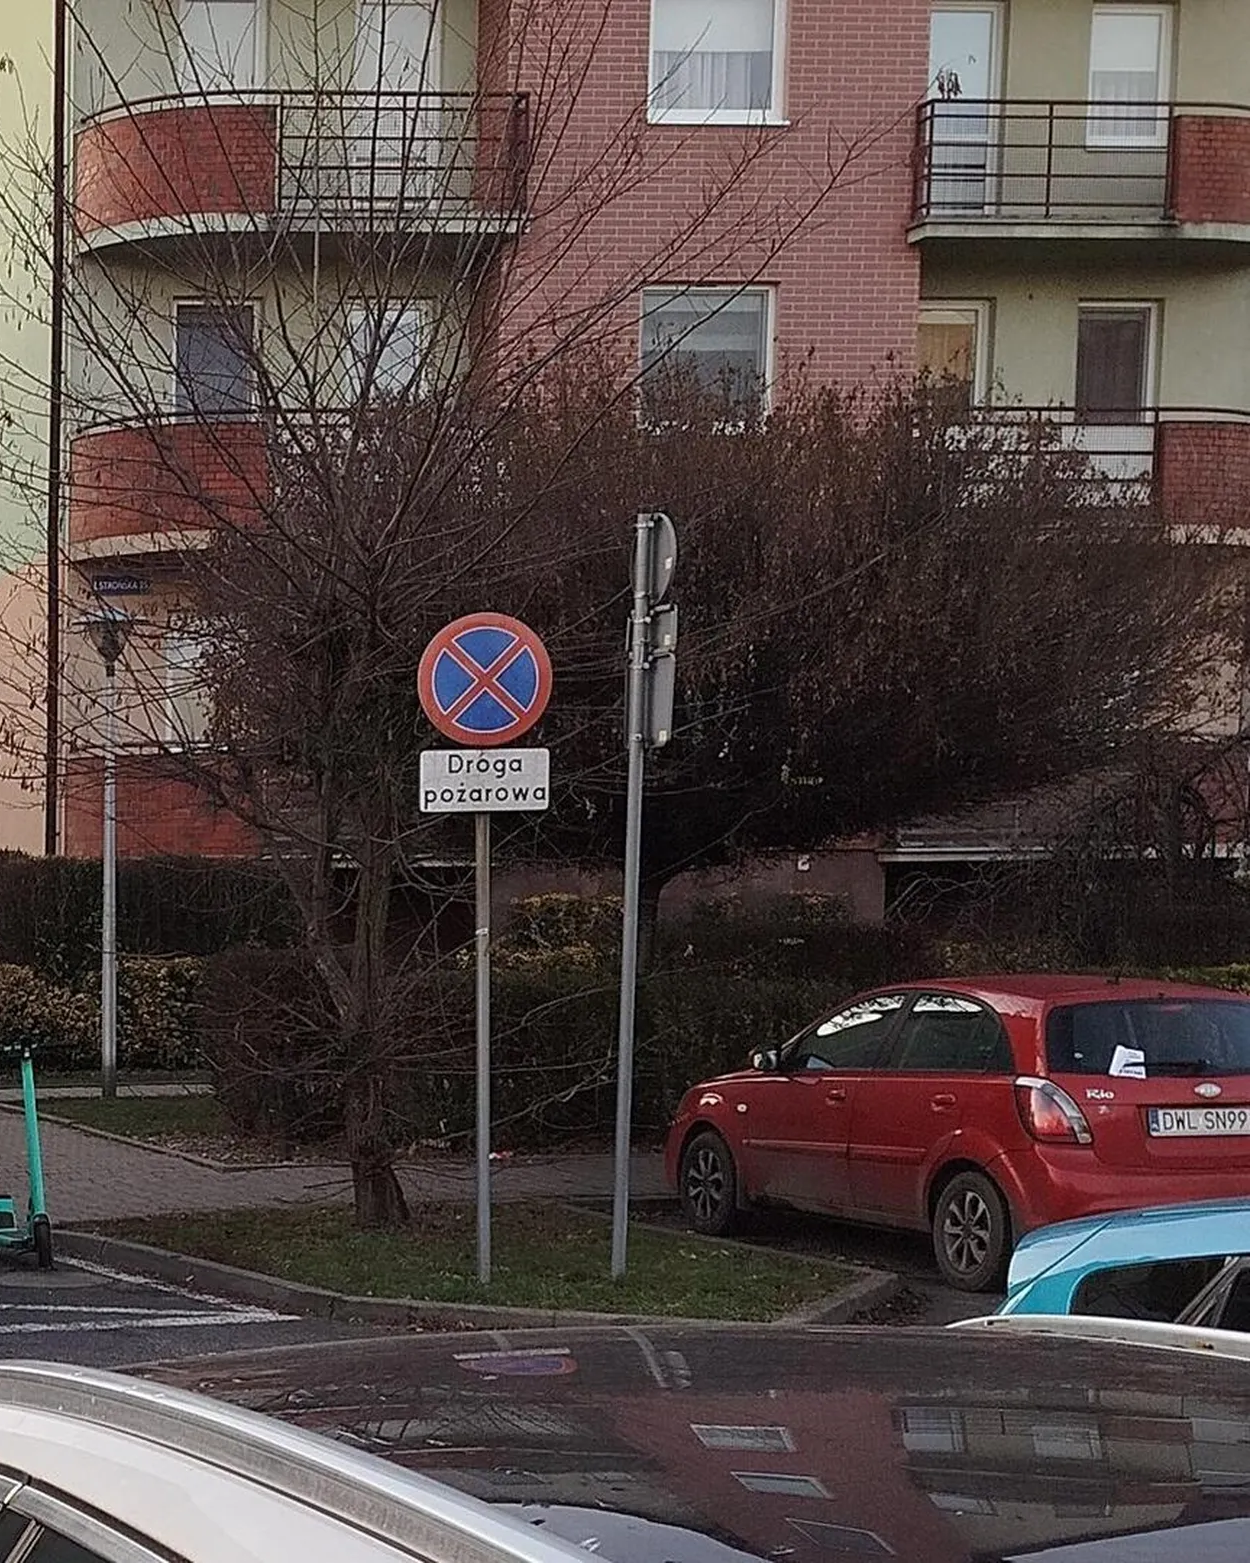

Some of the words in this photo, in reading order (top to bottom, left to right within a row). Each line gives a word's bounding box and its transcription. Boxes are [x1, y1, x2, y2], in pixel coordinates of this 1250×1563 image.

[424, 782, 547, 810] pożarowa
[1085, 1088, 1116, 1100] Rio
[1162, 1111, 1198, 1131] DWL
[1204, 1110, 1249, 1130] SN99
